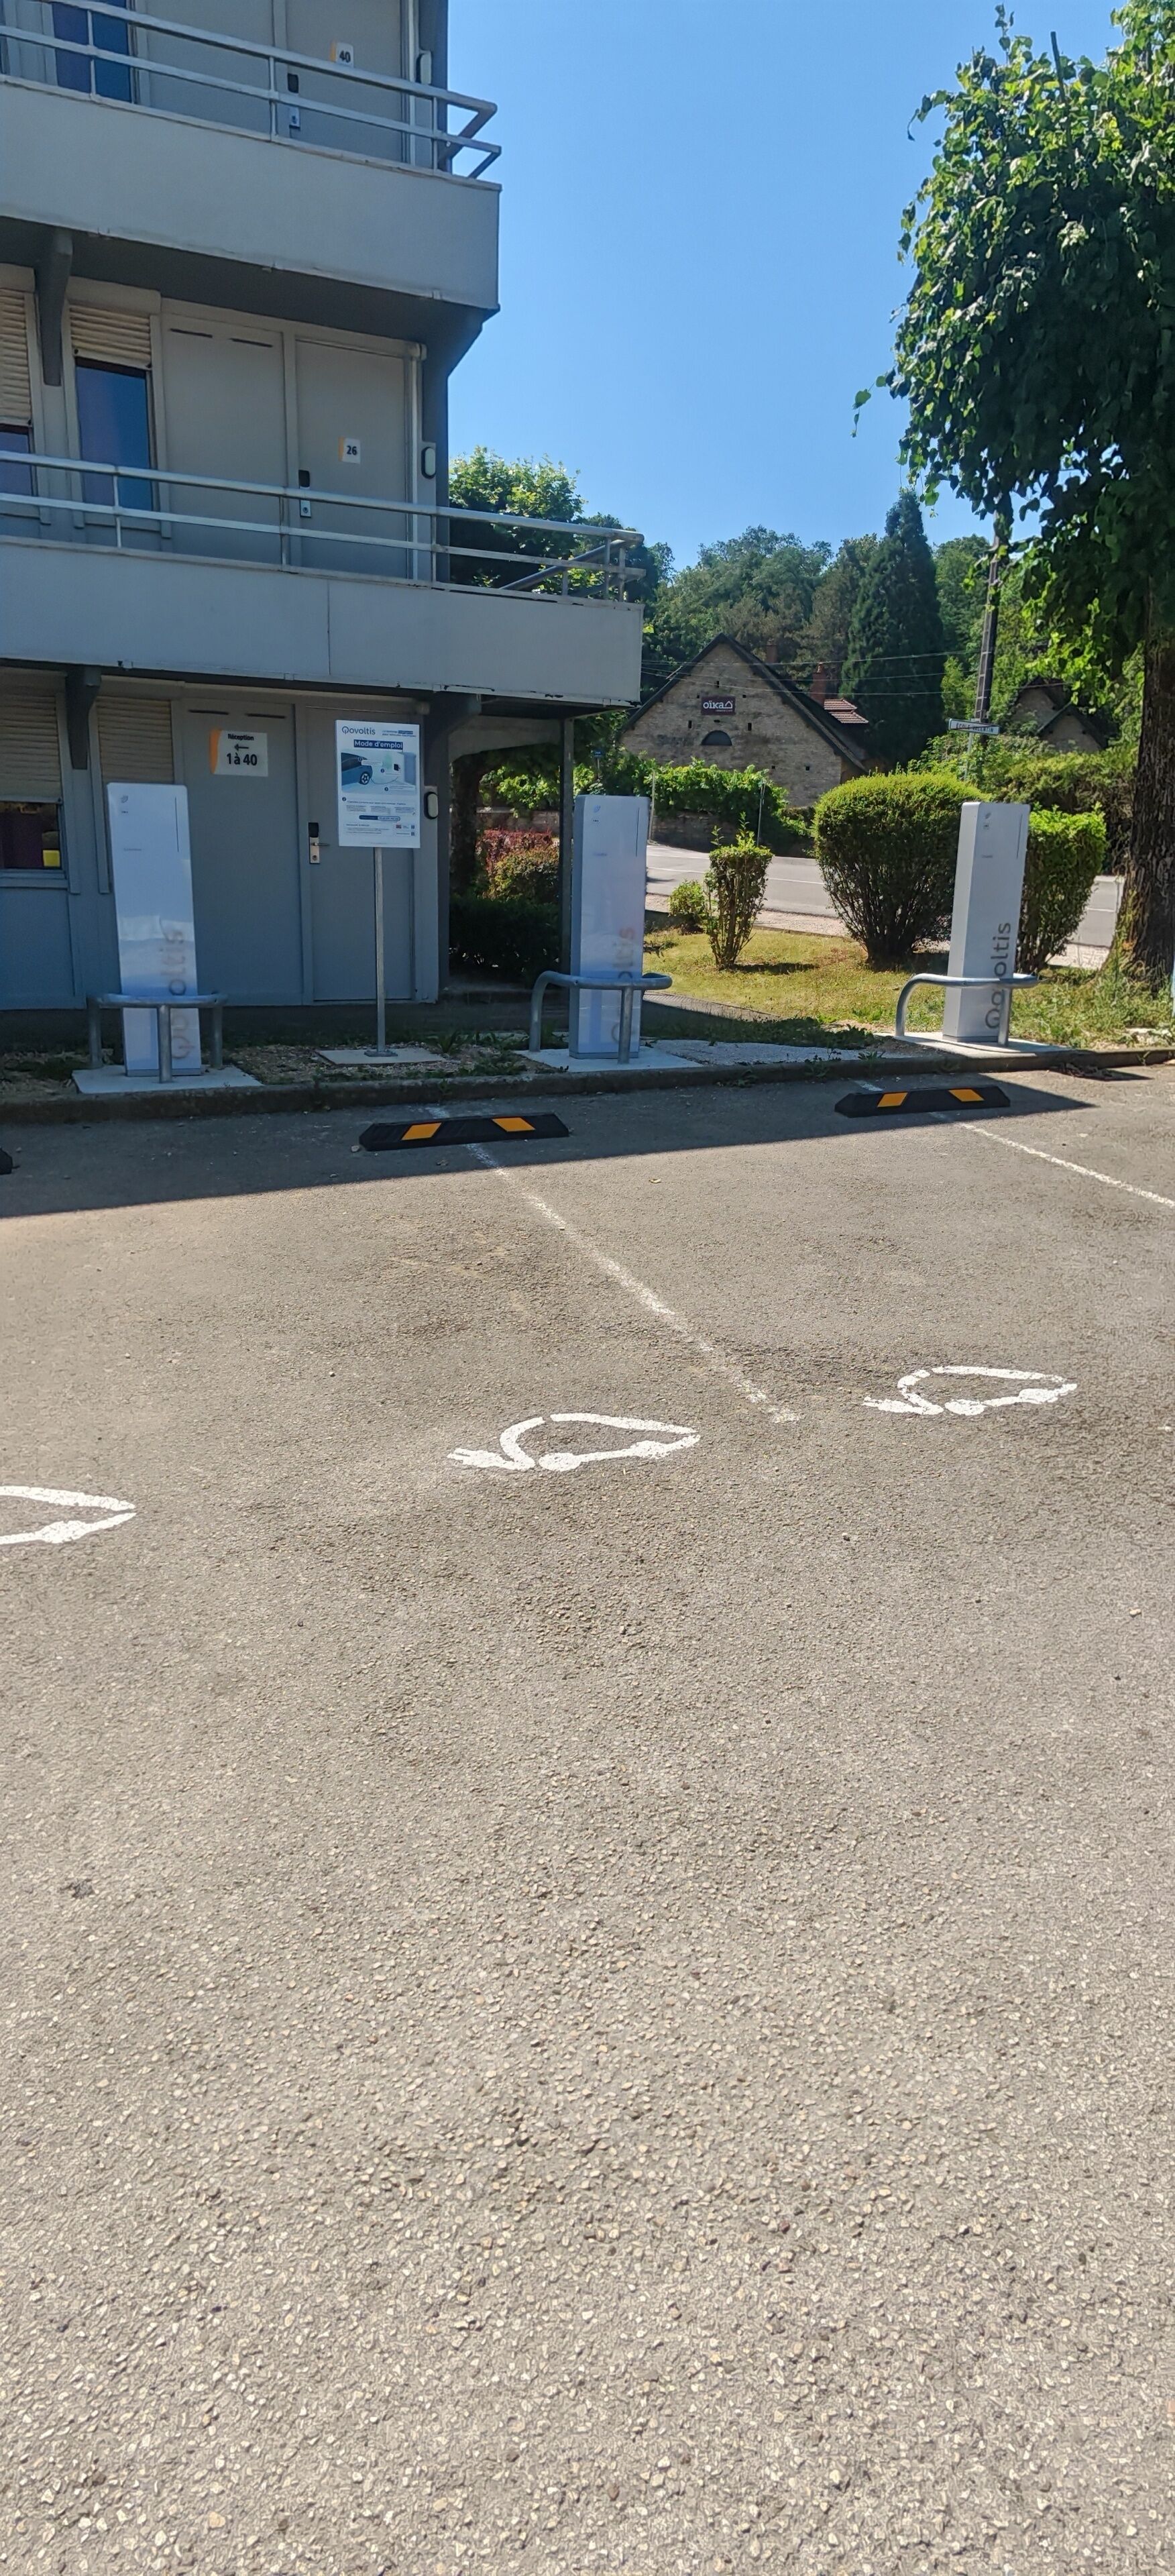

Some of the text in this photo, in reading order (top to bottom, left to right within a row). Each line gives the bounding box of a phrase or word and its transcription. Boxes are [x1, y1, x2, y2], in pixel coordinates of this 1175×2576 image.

[339, 50, 351, 63] 40
[347, 445, 357, 455] 26
[341, 726, 376, 735] Qovoltis
[374, 741, 402, 749] d'emploi
[227, 752, 258, 766] 1 à 40
[985, 922, 1011, 1029] Qooltis
